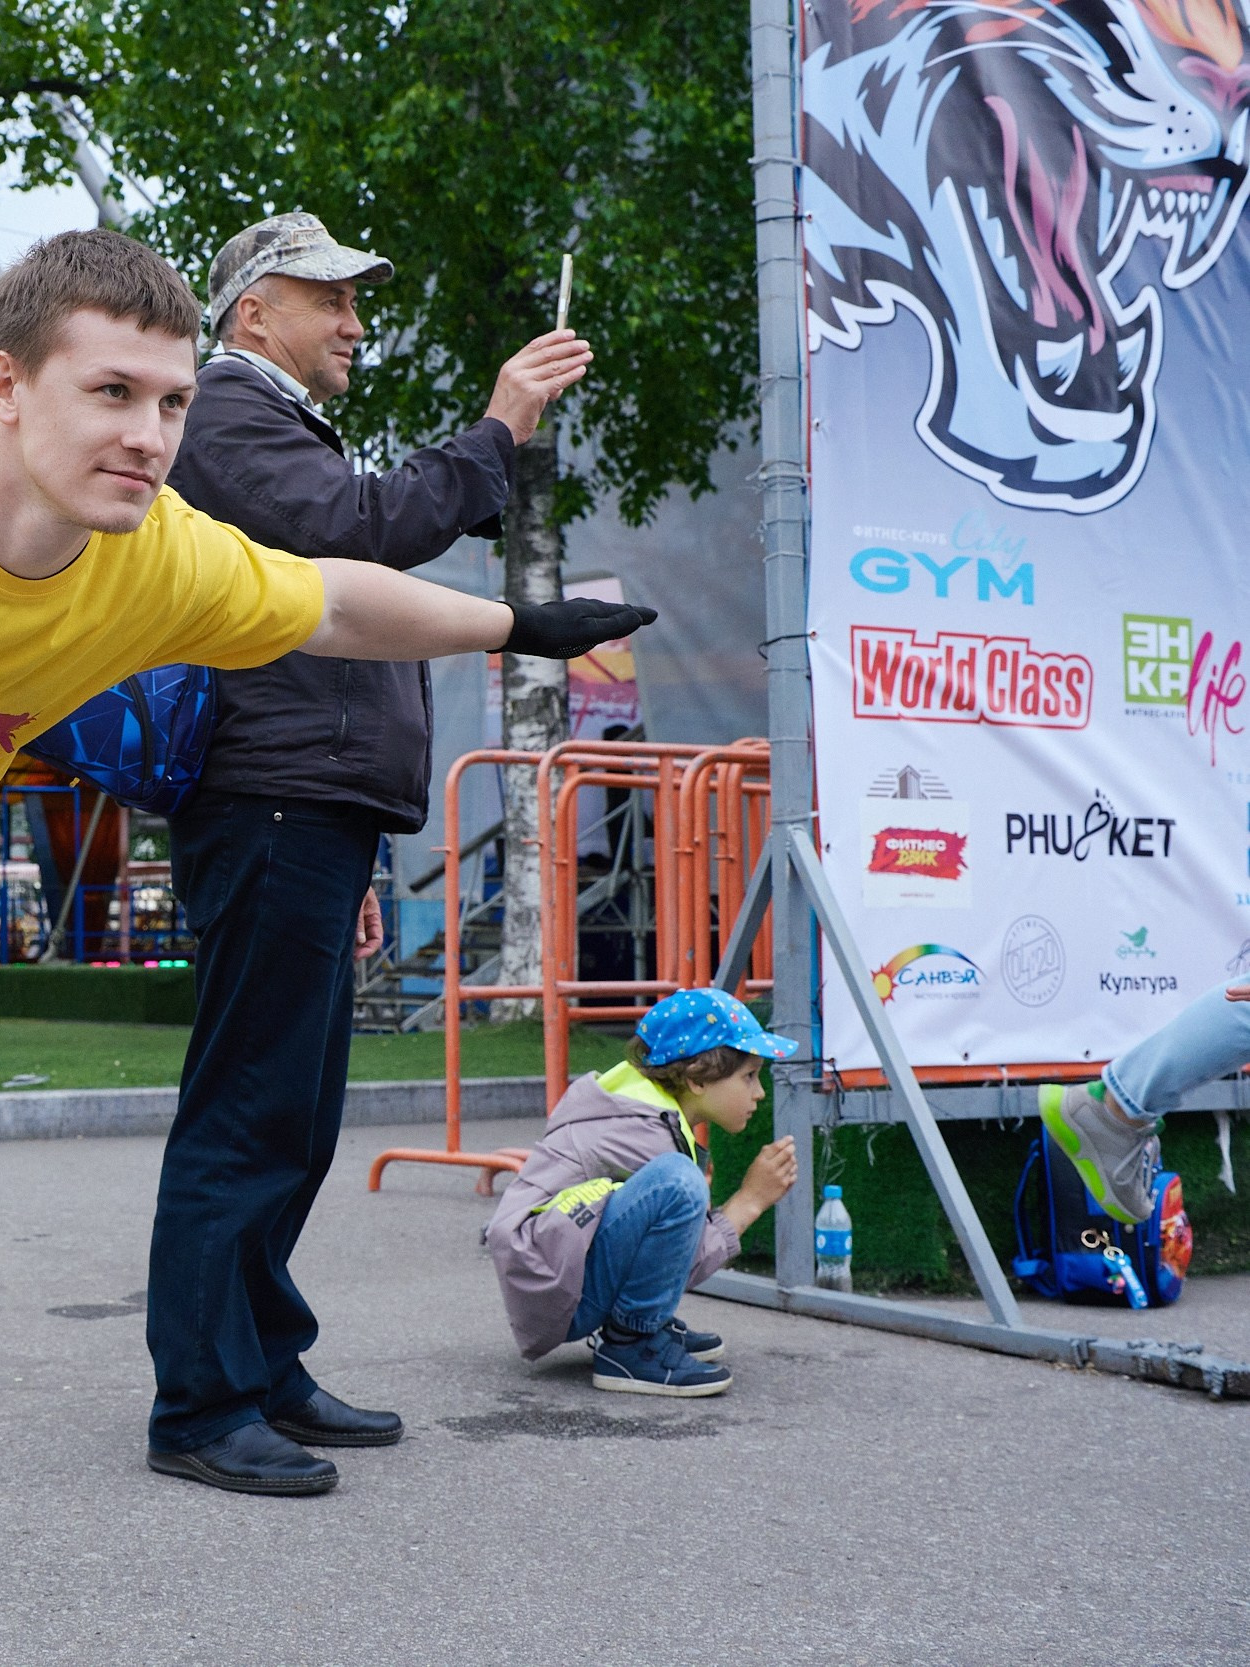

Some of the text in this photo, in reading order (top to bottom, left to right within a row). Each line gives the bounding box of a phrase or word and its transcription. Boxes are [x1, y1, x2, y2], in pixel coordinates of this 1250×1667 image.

[853, 525, 948, 545] ФИТНЕС-КЛУБ
[849, 547, 1035, 606] GYM
[861, 639, 1085, 718] World Class
[1187, 631, 1247, 768] life
[885, 838, 947, 852] ФИТНЕС
[1099, 972, 1178, 995] Культура
